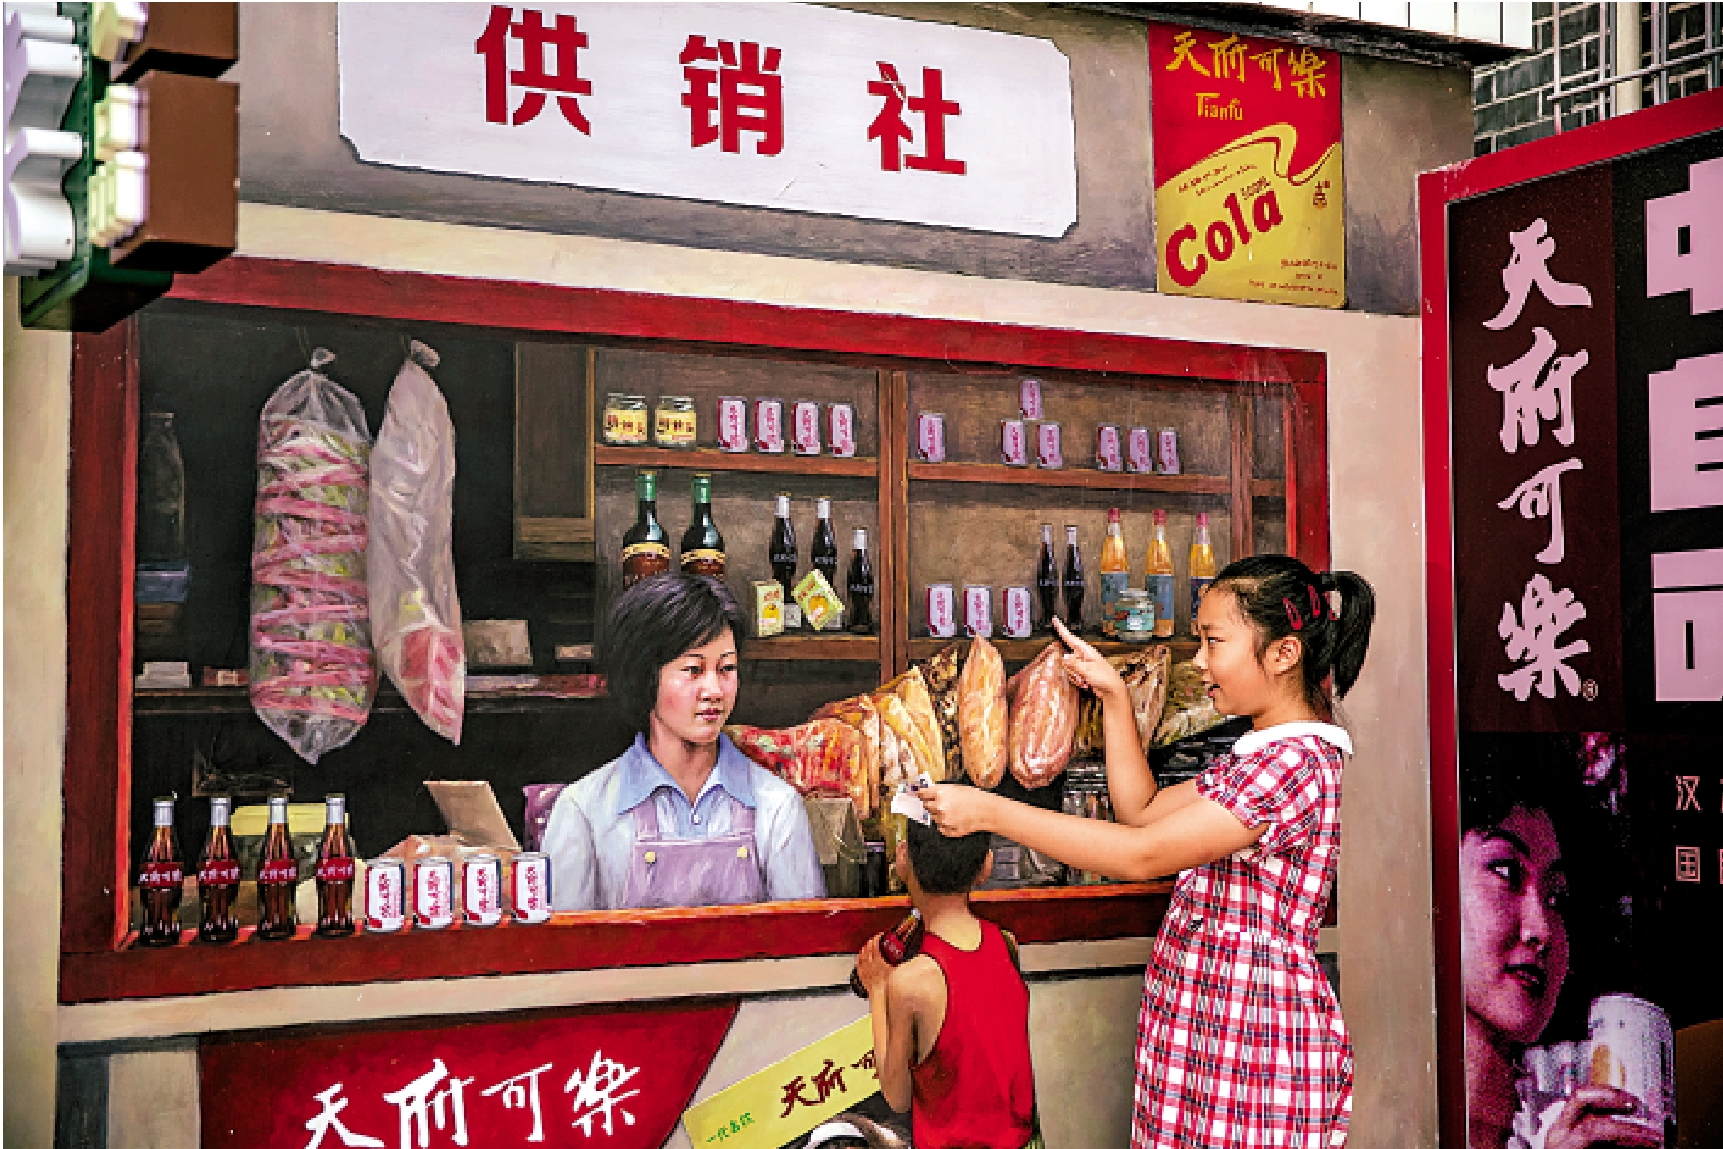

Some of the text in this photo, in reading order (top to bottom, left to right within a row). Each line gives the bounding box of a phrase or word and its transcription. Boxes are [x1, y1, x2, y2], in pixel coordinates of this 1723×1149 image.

[476, 4, 967, 176] 供销社
[1196, 92, 1244, 121] Tianfu
[1165, 190, 1284, 287] Cola
